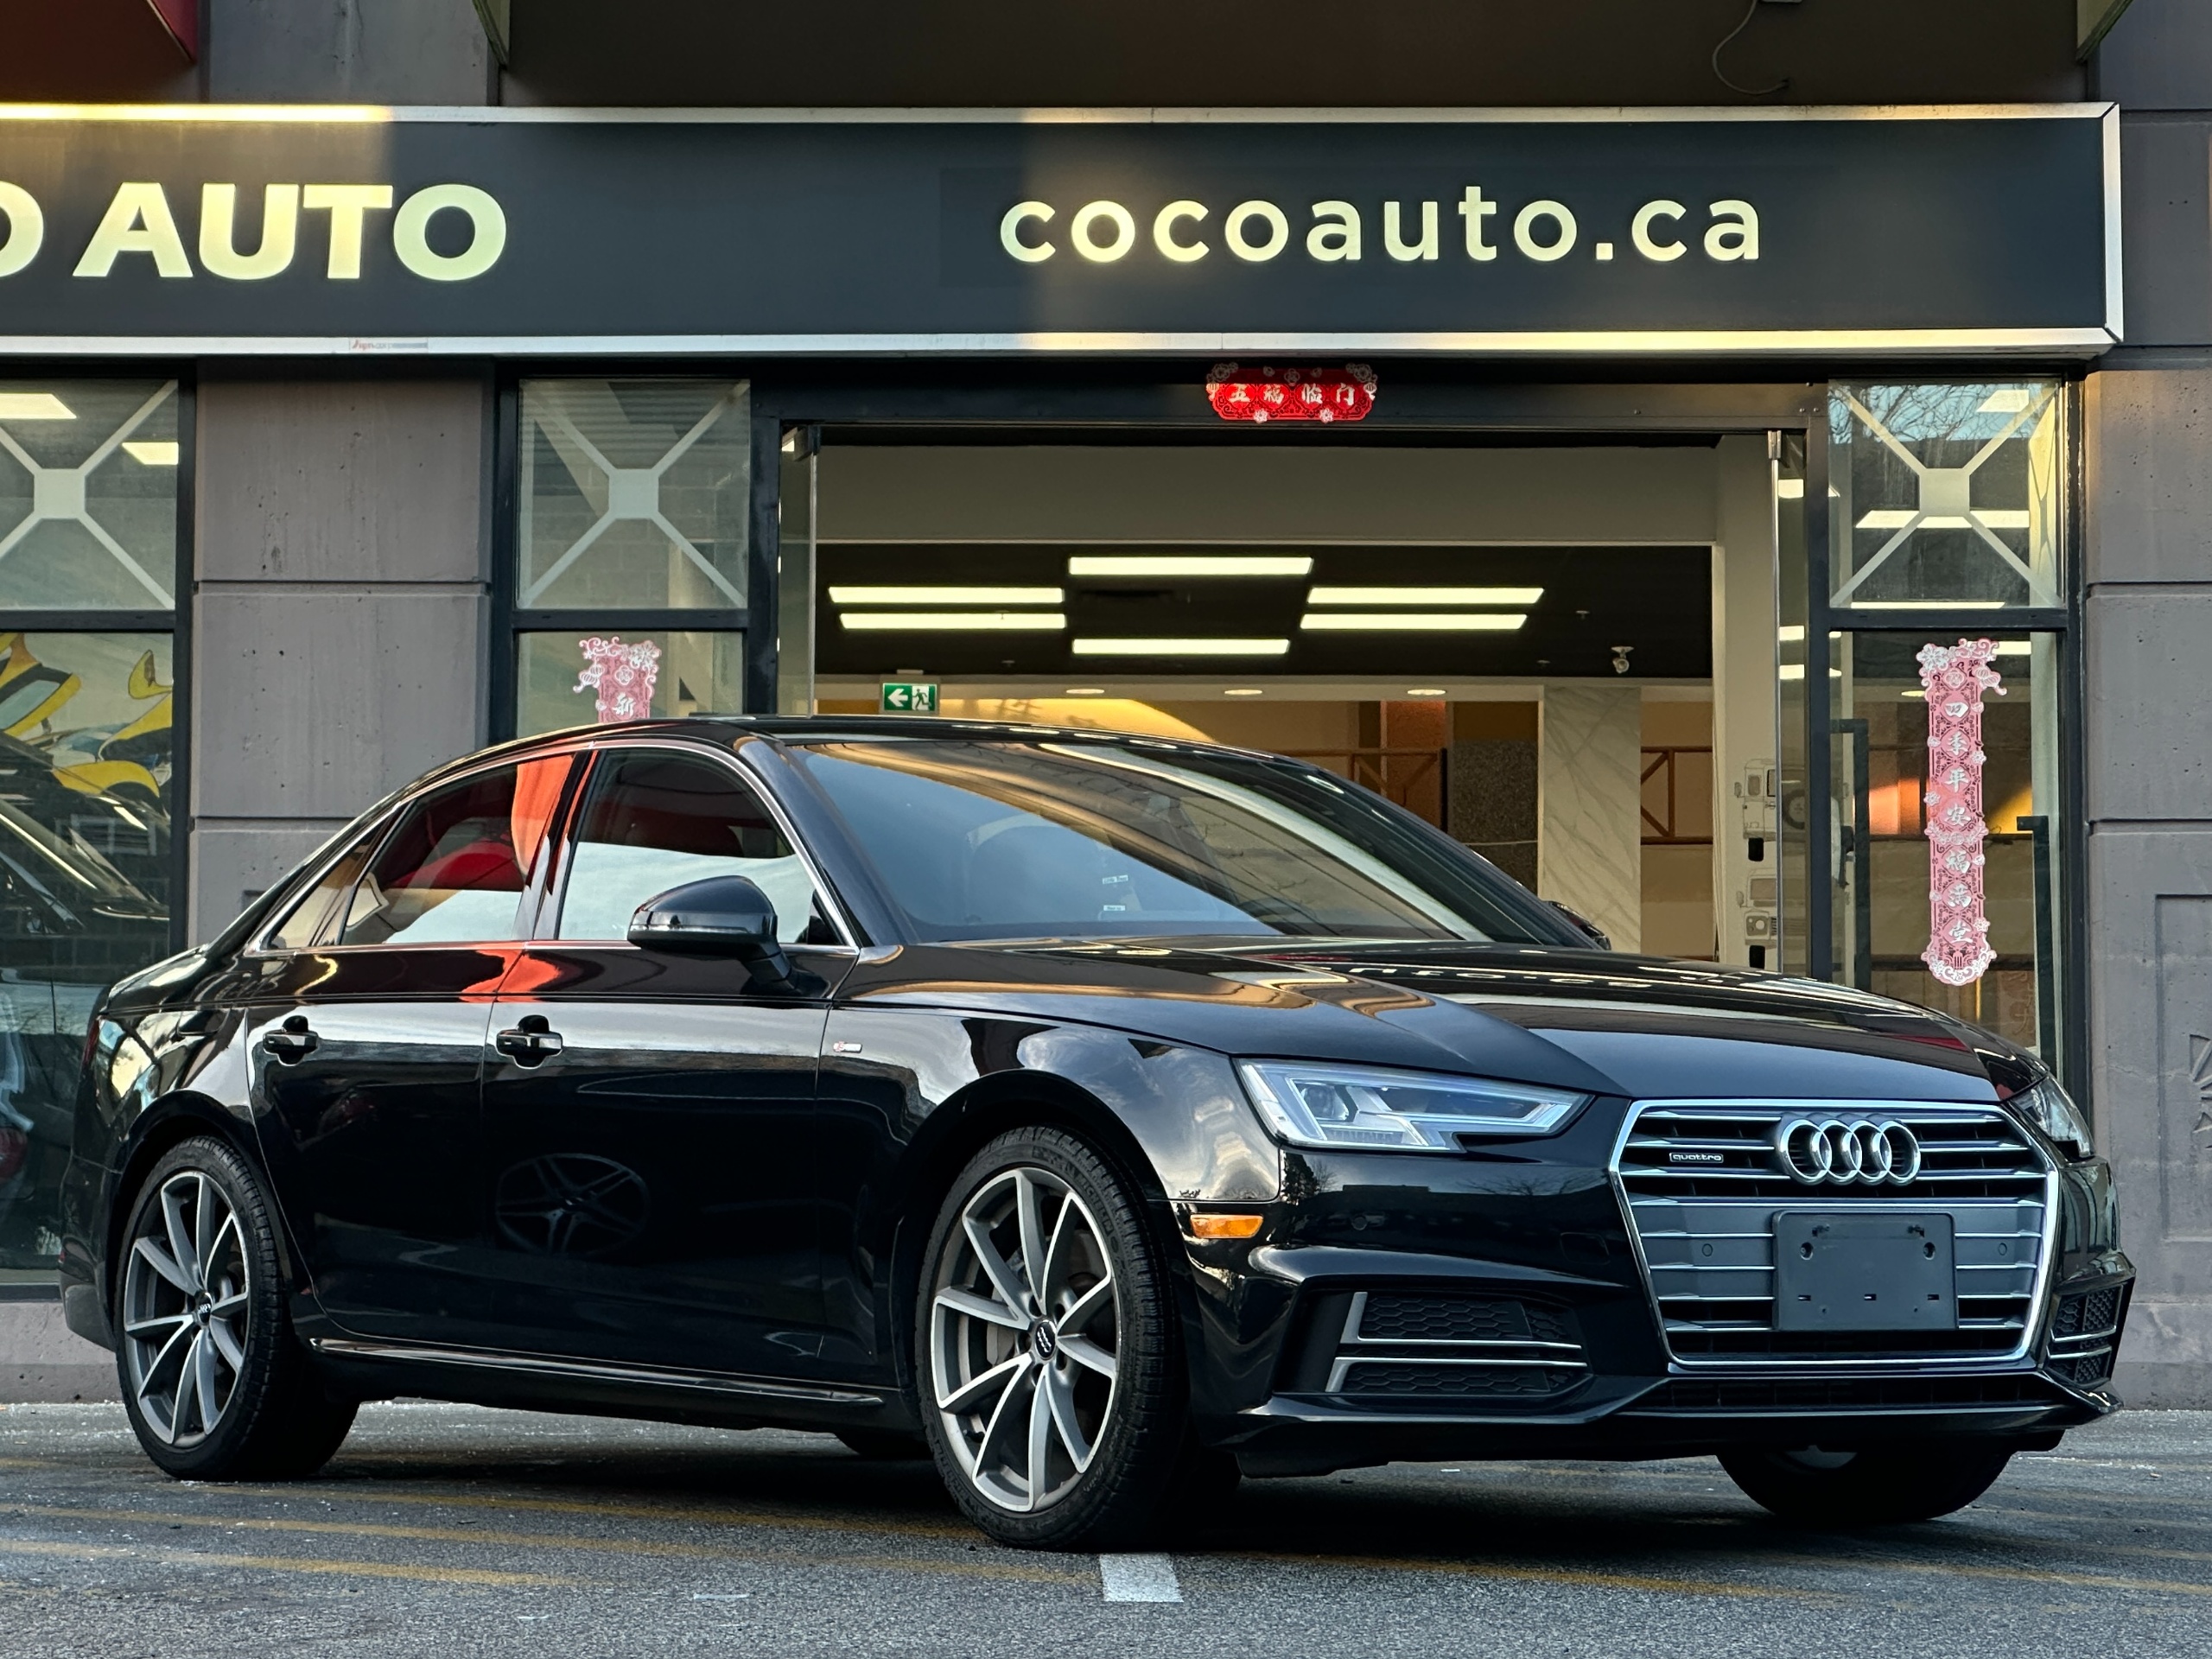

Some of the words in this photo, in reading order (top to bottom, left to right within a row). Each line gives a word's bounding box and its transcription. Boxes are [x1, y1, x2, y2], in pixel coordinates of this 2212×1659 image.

[73, 181, 507, 281] AUTO
[1000, 185, 1760, 263] cocoauto.ca
[1228, 382, 1356, 406] 五福临门
[612, 691, 637, 717] 新
